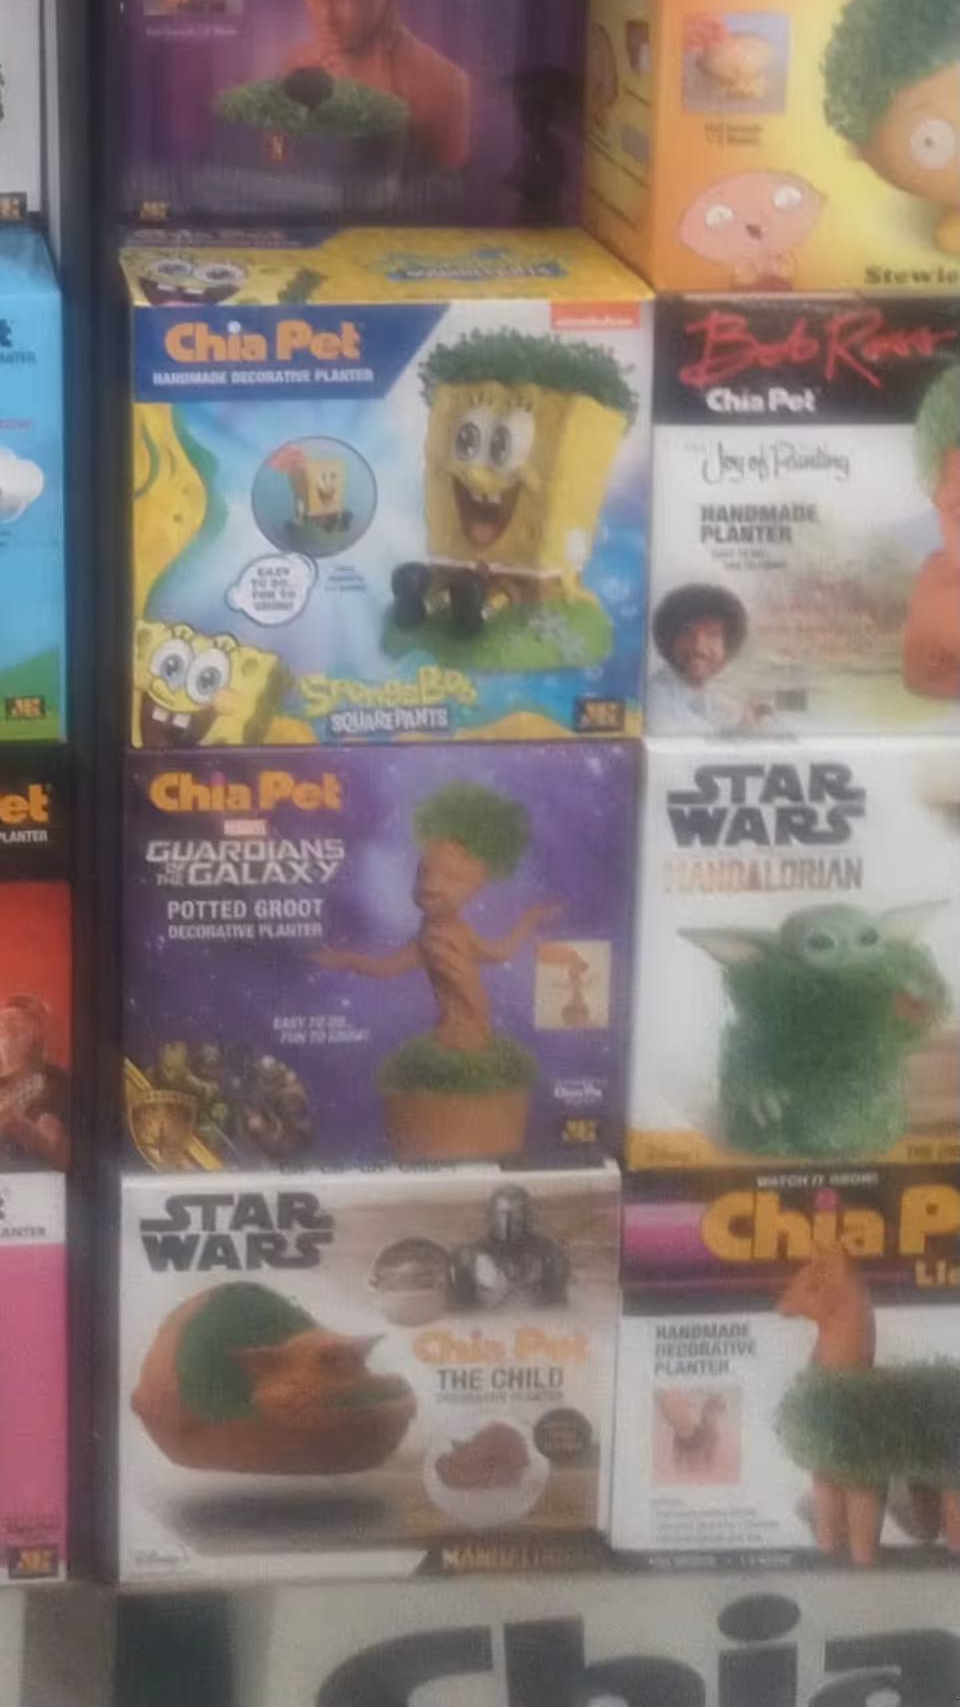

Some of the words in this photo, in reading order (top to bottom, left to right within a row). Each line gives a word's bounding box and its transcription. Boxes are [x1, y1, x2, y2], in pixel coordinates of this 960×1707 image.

[165, 321, 267, 363] Chia
[276, 320, 361, 360] Pet
[154, 371, 227, 386] HANDMADE
[231, 369, 311, 384] DECORATIVE
[314, 368, 374, 383] PLANTER
[706, 387, 764, 413] Chia
[768, 386, 817, 412] Pet
[699, 503, 818, 524] HANDMADE
[700, 525, 792, 544] PLANTER
[150, 772, 251, 811] Chia
[258, 771, 342, 810] Pet
[667, 763, 866, 804] STAR
[668, 804, 865, 848] WARS
[145, 839, 345, 862] GUARDIANS
[188, 859, 339, 886] GALAXY
[167, 900, 247, 919] POTTED
[255, 899, 324, 917] GROOT
[168, 924, 254, 939] DECORATIVE
[258, 922, 322, 937] PLANTER
[141, 1191, 335, 1232] STAR
[701, 1187, 885, 1261] Chia
[141, 1232, 334, 1272] WARS
[412, 1329, 508, 1364] Chia
[514, 1327, 587, 1362] Pet
[440, 1368, 485, 1390] THE
[491, 1366, 564, 1390] CHILD
